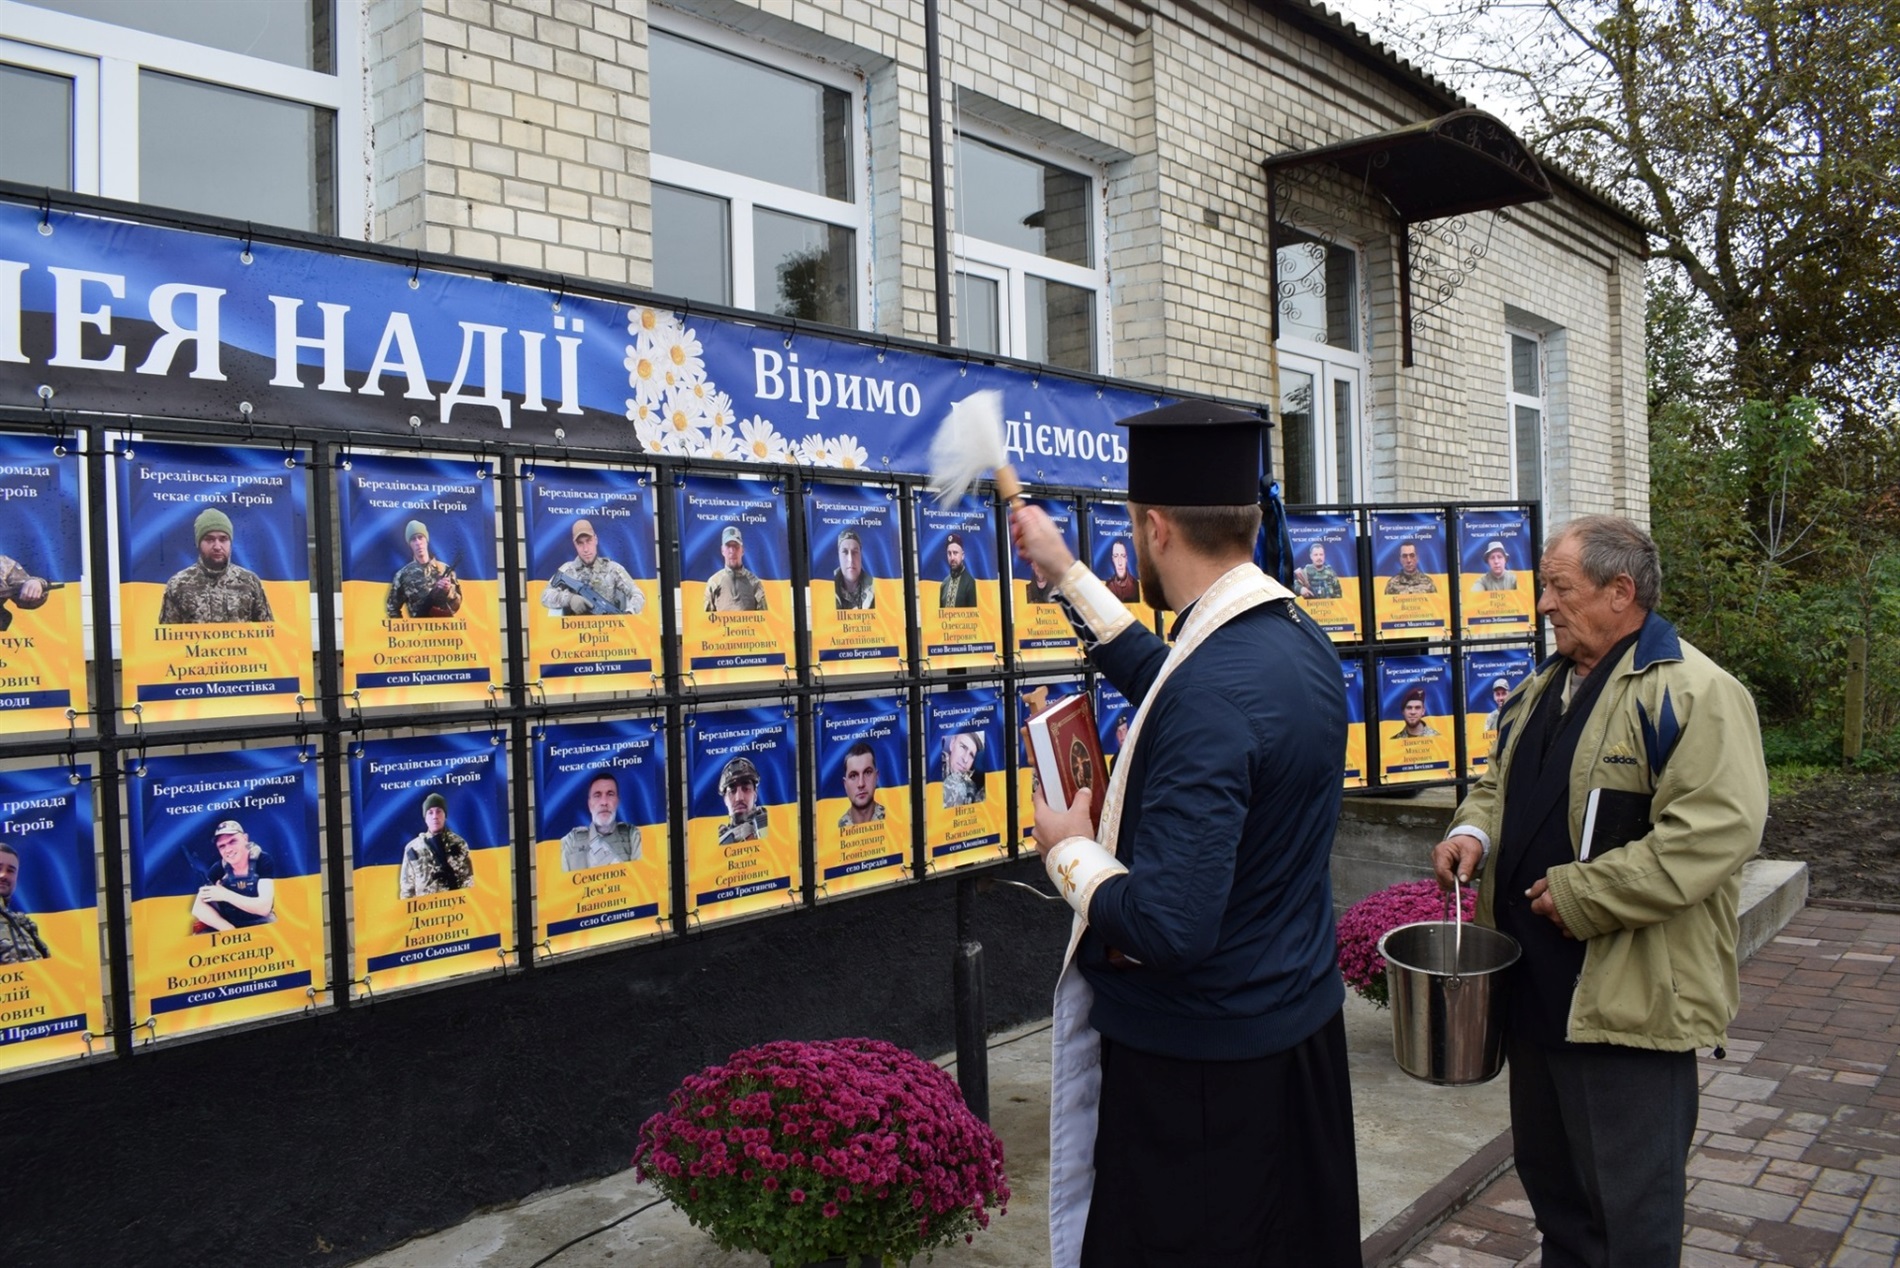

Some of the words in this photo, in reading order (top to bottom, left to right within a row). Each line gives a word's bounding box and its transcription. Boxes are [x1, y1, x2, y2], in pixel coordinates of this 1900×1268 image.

[269, 295, 585, 429] НАДІЇ
[752, 348, 921, 420] Віримо
[1002, 410, 1128, 464] діємось
[140, 467, 228, 484] Берездівська
[230, 475, 283, 487] громада
[357, 476, 430, 492] Берездівська
[431, 484, 476, 495] громада
[152, 492, 190, 502] чекає
[193, 491, 228, 503] своїх
[231, 491, 273, 507] Героїв
[538, 486, 599, 500] Берездівська
[600, 492, 637, 503] громада
[688, 494, 740, 508] Берездівська
[740, 500, 772, 510] громада
[369, 498, 400, 508] чекає
[401, 498, 430, 510] своїх
[432, 499, 468, 513] Героїв
[547, 506, 574, 515] чекає
[575, 505, 600, 516] своїх
[601, 505, 631, 519] Героїв
[815, 500, 859, 512] Берездівська
[859, 505, 887, 514] громада
[696, 513, 719, 521] чекає
[719, 512, 741, 522] своїх
[741, 512, 767, 524] Героїв
[821, 517, 841, 525] чекає
[841, 516, 860, 525] своїх
[860, 516, 882, 527] Героїв
[381, 617, 467, 637] Чайгуцький
[561, 617, 625, 633] Бондарчук
[154, 625, 275, 645] Пінчуковський
[387, 633, 463, 650] Володимир
[578, 631, 609, 647] Юрій
[185, 644, 247, 658] Максим
[372, 649, 477, 667] Олександрович
[550, 647, 637, 662] Олександрович
[165, 661, 267, 681] Аркадійович
[573, 665, 594, 674] село
[595, 662, 621, 674] Кутки
[386, 675, 410, 684] село
[411, 671, 471, 685] Красностав
[174, 686, 203, 696] село
[206, 680, 275, 694] Модестівка
[825, 717, 869, 730] Берездівська
[869, 714, 896, 725] громада
[698, 728, 750, 743] Берездівська
[750, 725, 783, 738] громада
[831, 733, 851, 742] чекає
[851, 729, 869, 740] своїх
[869, 727, 891, 739] Героїв
[549, 743, 611, 758] Берездівська
[612, 739, 649, 753] громада
[705, 746, 728, 755] чекає
[729, 742, 750, 753] своїх
[751, 739, 777, 752] Героїв
[369, 758, 442, 775] Берездівська
[444, 754, 489, 769] громада
[558, 762, 585, 772] чекає
[586, 757, 611, 770] своїх
[612, 754, 643, 769] Героїв
[1603, 755, 1637, 765] adidas
[152, 779, 240, 799] Берездівська
[243, 774, 296, 791] громада
[380, 780, 412, 791] чекає
[413, 774, 443, 788] своїх
[445, 770, 481, 786] Героїв
[3, 796, 67, 815] громада
[165, 803, 204, 815] чекає
[206, 797, 241, 812] своїх
[244, 793, 286, 810] Героїв
[4, 817, 54, 836] Героїв
[723, 844, 760, 858] Санчук
[727, 858, 757, 871] Вадим
[571, 868, 627, 885] Семенюк
[714, 869, 769, 888] Сергійович
[716, 890, 734, 899] село
[406, 895, 466, 917] Поліщук
[576, 896, 627, 914] Іванович
[408, 912, 464, 932] Дмитро
[579, 917, 600, 927] село
[209, 930, 252, 948] Гона
[404, 925, 469, 948] Іванович
[188, 946, 274, 968] Олександр
[399, 951, 424, 963] село
[424, 942, 470, 958] Сьомаки
[167, 958, 295, 990] Володимирович
[187, 991, 216, 1003] село
[217, 975, 278, 997] Хвощівка
[8, 1019, 79, 1041] Правутин
